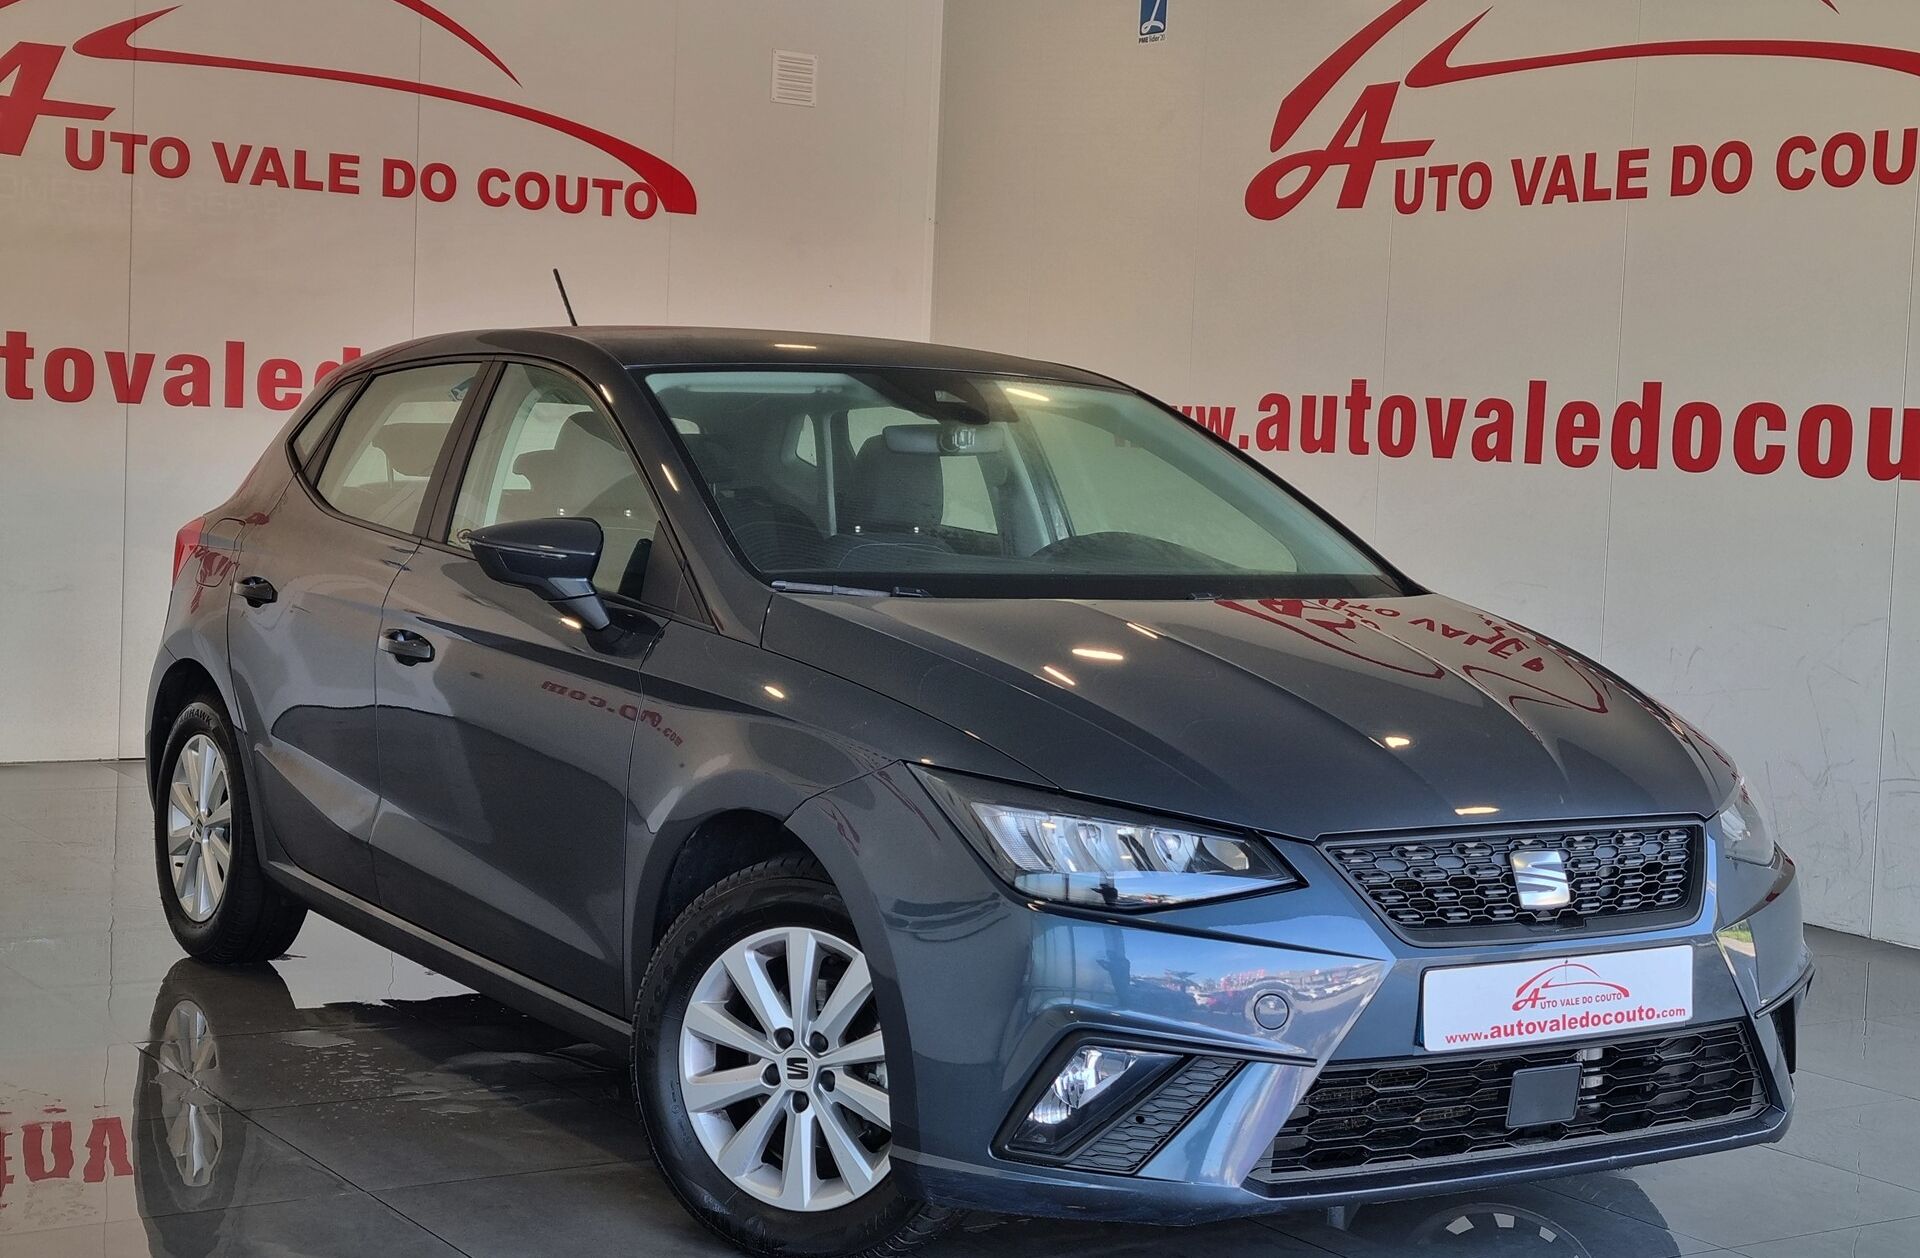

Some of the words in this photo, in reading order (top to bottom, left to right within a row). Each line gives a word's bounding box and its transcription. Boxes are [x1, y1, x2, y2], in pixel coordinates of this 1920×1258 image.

[1243, 81, 1493, 221] AUTO
[1511, 147, 1650, 206] VALE
[1669, 139, 1754, 197] DO
[212, 142, 361, 196] VALE
[382, 158, 458, 204] DO
[477, 167, 660, 220] COUTO
[1445, 1004, 1686, 1044] www.autovaledocouto.com
[1512, 988, 1558, 1011] AUTO
[1560, 997, 1580, 1007] VALE
[1582, 995, 1593, 1004] DO
[1595, 992, 1622, 1003] COUTO
